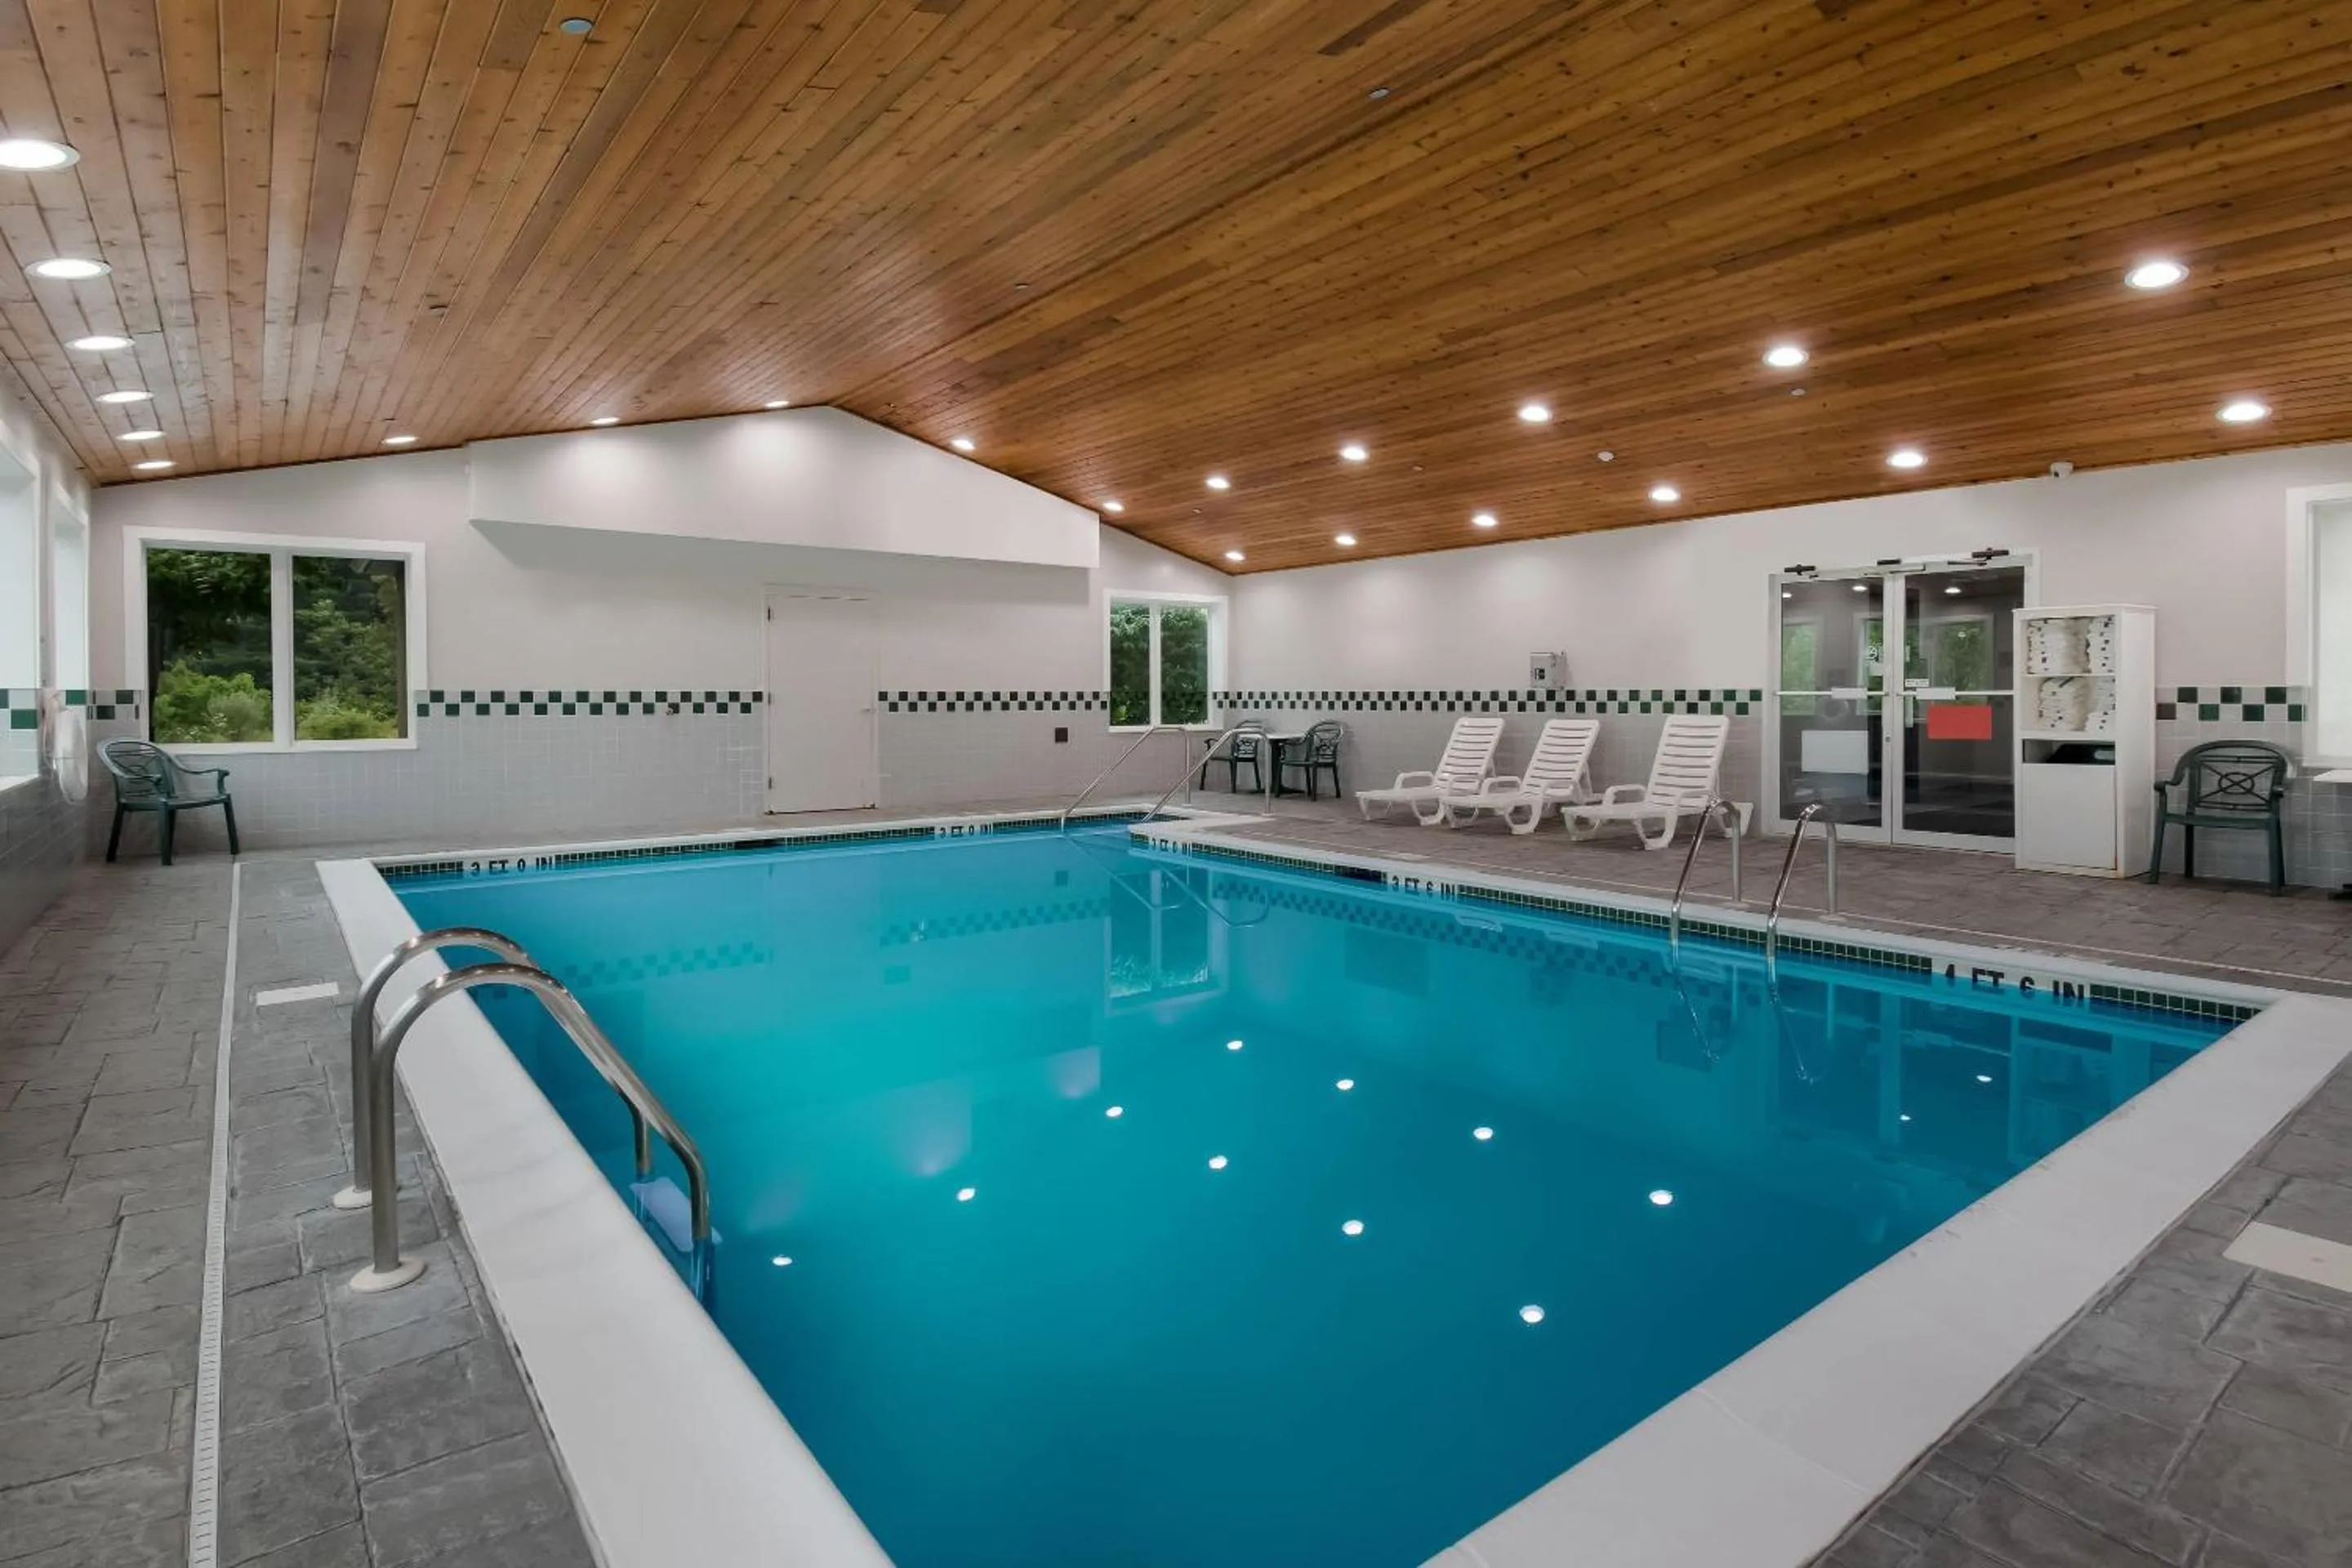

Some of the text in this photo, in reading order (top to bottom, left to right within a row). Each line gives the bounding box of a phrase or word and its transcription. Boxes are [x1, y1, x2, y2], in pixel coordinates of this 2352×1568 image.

[1440, 882, 1456, 896] IN
[1971, 967, 2005, 987] FT
[2052, 979, 2085, 999] IN
